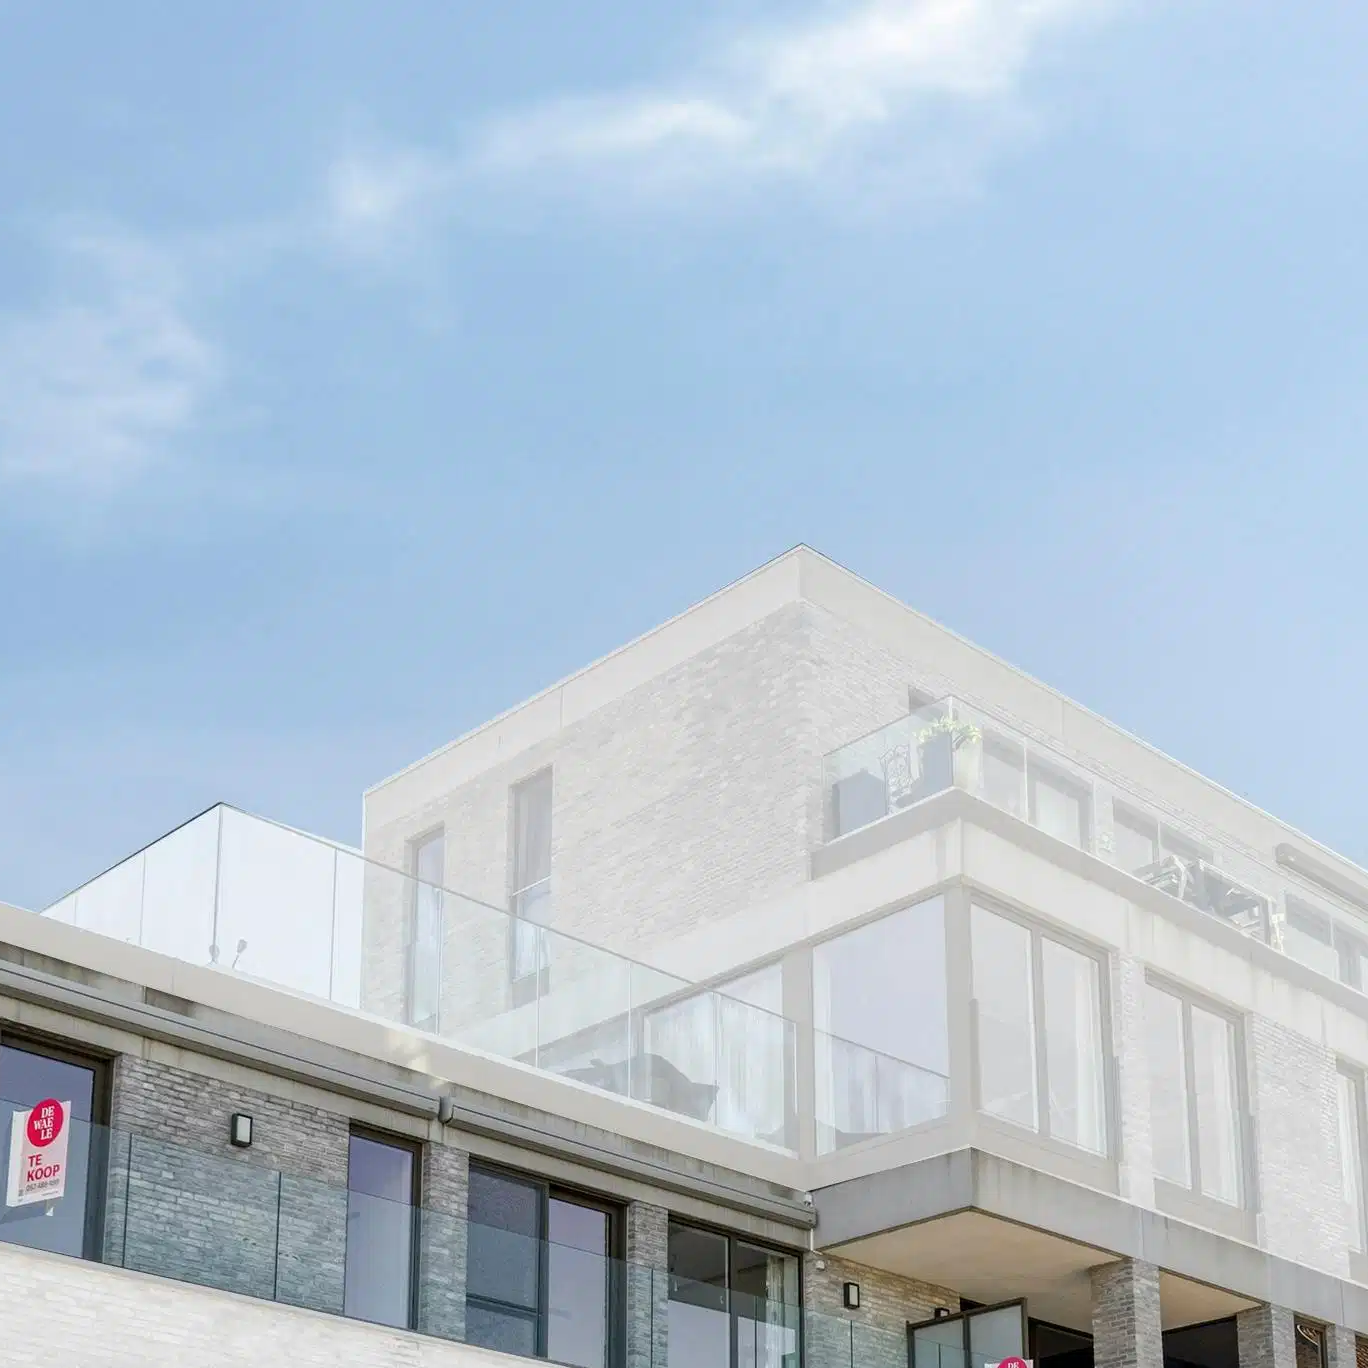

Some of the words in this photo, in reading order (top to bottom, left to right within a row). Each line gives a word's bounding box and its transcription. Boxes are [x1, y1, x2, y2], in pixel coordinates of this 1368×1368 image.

[41, 1106, 55, 1118] DE
[33, 1117, 54, 1130] WAE
[40, 1128, 53, 1140] LE
[28, 1153, 43, 1167] TE
[27, 1164, 60, 1182] KOOP
